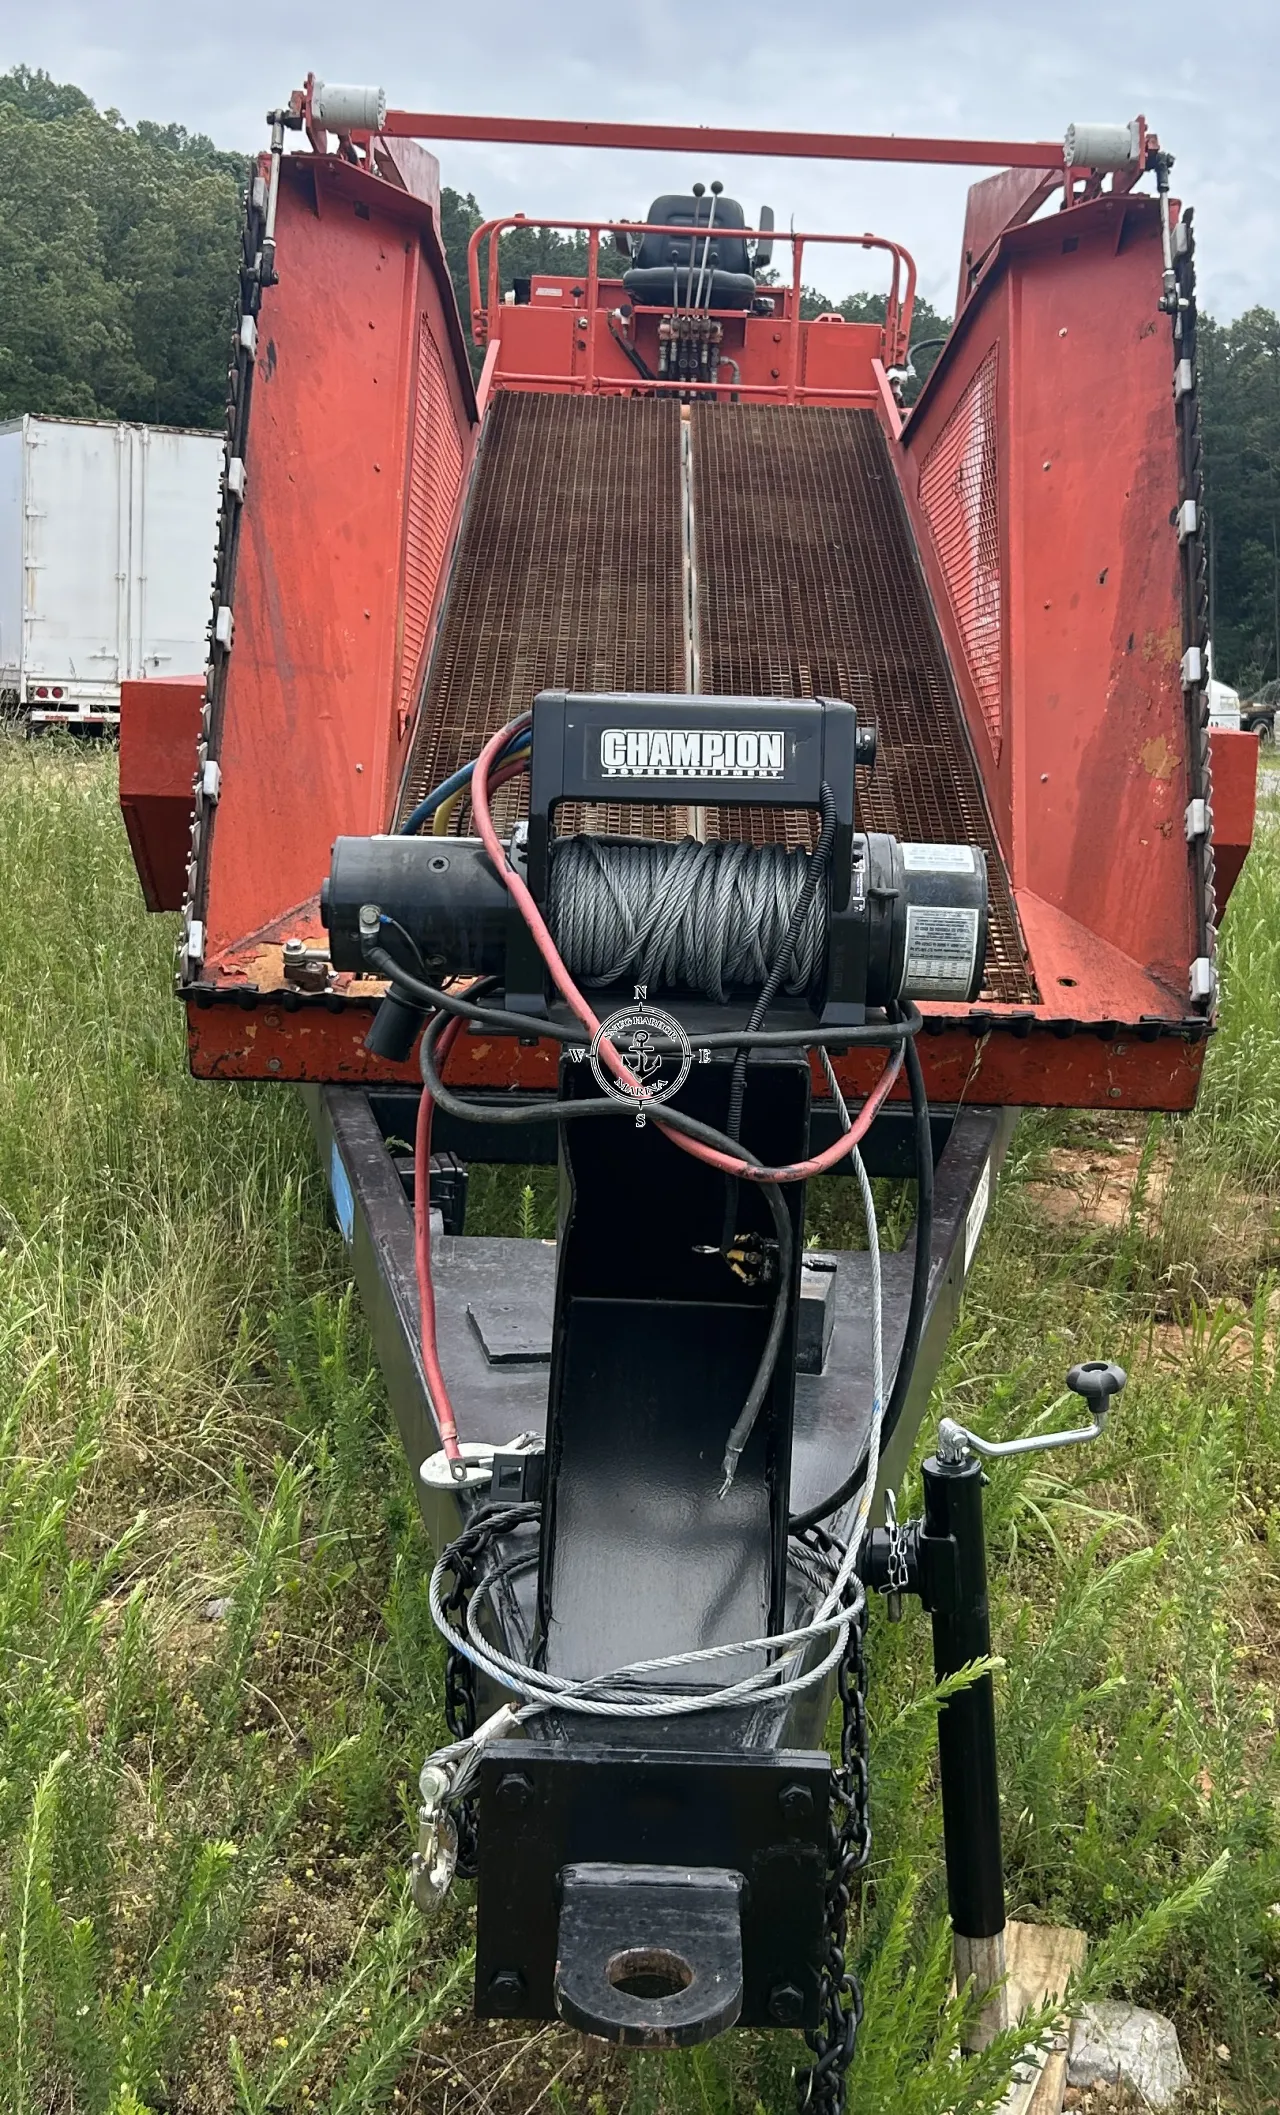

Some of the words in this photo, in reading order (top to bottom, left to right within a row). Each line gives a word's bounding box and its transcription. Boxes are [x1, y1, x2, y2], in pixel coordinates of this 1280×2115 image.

[600, 729, 785, 770] CHAMPION
[607, 768, 668, 776] POWER
[676, 769, 780, 777] EQUIPMENT
